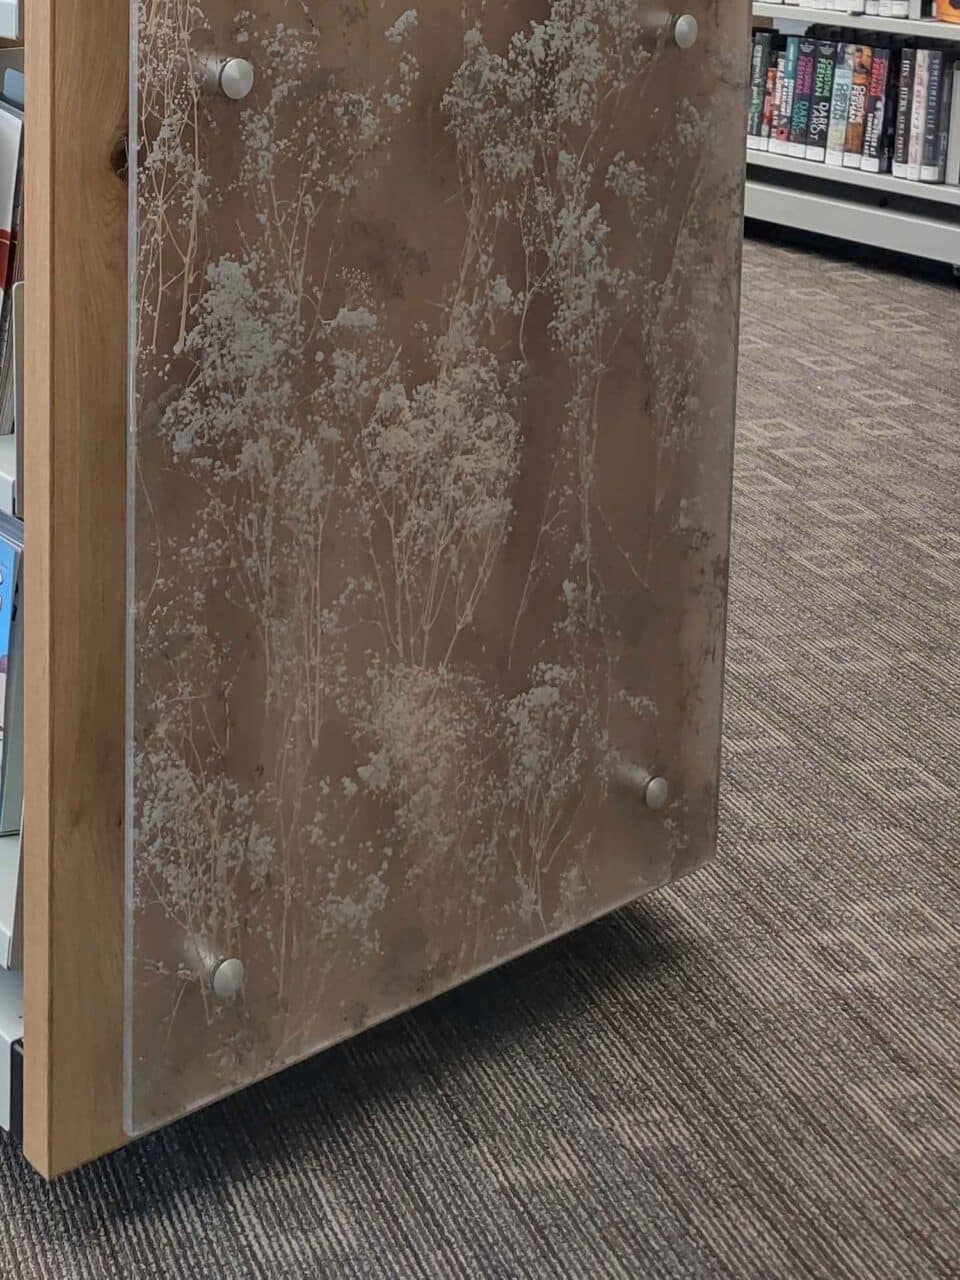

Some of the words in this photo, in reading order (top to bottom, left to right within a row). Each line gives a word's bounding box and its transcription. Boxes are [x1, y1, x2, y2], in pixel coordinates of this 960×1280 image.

[795, 56, 806, 94] FEEHAN
[814, 57, 826, 97] FEEHAN
[823, 58, 834, 98] CHRISTINE
[928, 58, 940, 106] SOMETIMES
[798, 100, 809, 130] DARK
[818, 101, 830, 132] DARK
[848, 84, 860, 123] FEEHAN
[855, 85, 867, 124] CHRISTINE
[899, 87, 909, 112] HERS
[809, 104, 822, 141] TAROT
